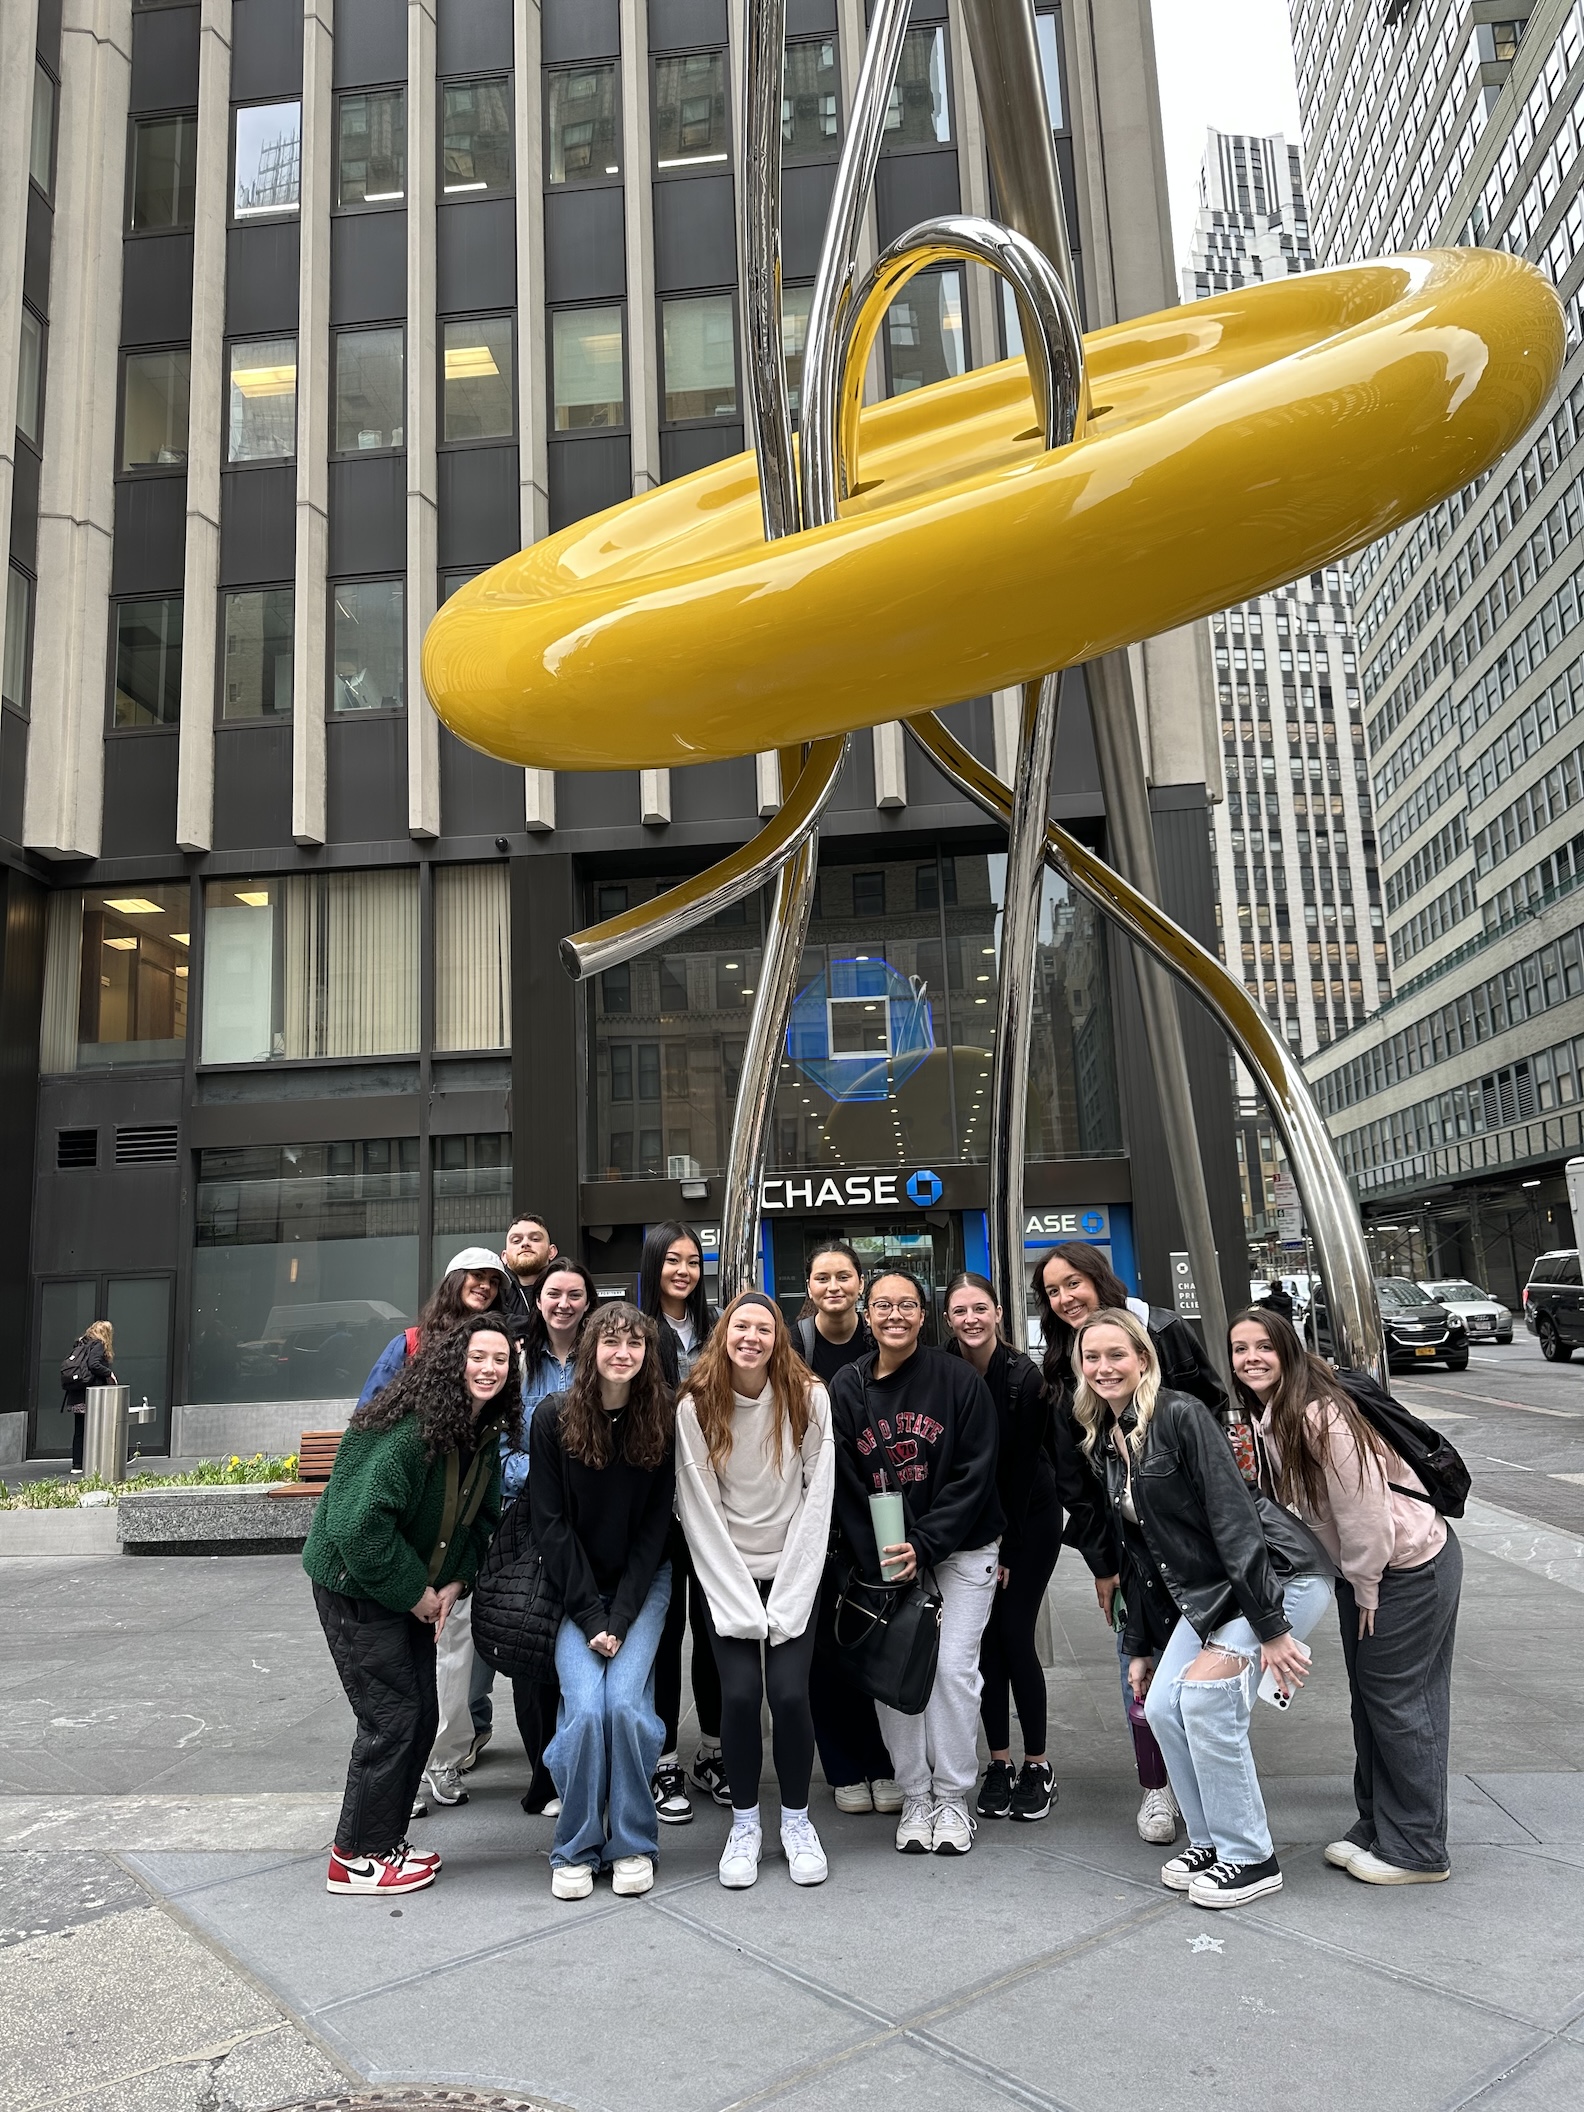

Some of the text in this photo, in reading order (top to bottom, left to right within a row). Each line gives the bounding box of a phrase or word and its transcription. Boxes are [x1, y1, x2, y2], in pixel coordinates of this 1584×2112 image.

[761, 1175, 900, 1209] CHASE
[1025, 1214, 1078, 1234] ASE
[1178, 1282, 1196, 1290] CHA
[1179, 1301, 1200, 1309] CLIE
[856, 1411, 945, 1456] OHO STATE
[900, 1443, 915, 1456] 70
